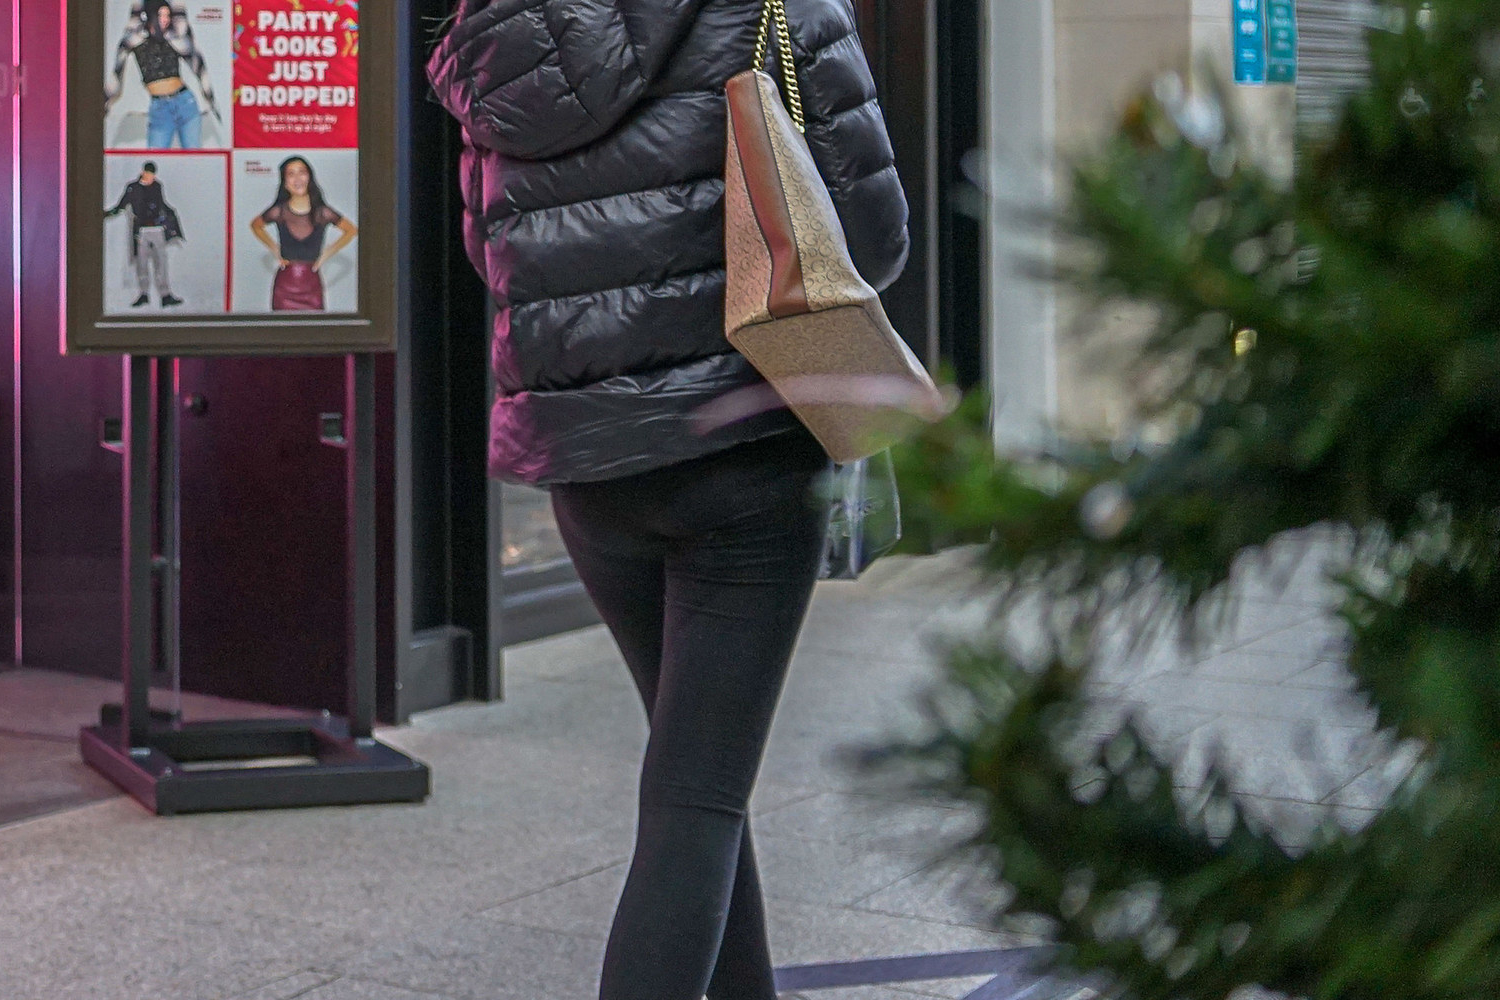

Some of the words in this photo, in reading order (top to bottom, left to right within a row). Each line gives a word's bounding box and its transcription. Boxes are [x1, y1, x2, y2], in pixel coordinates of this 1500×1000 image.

[258, 10, 338, 32] PARTY
[259, 36, 338, 57] LOOKS
[268, 61, 329, 82] JUST
[241, 85, 356, 107] DROPPED!
